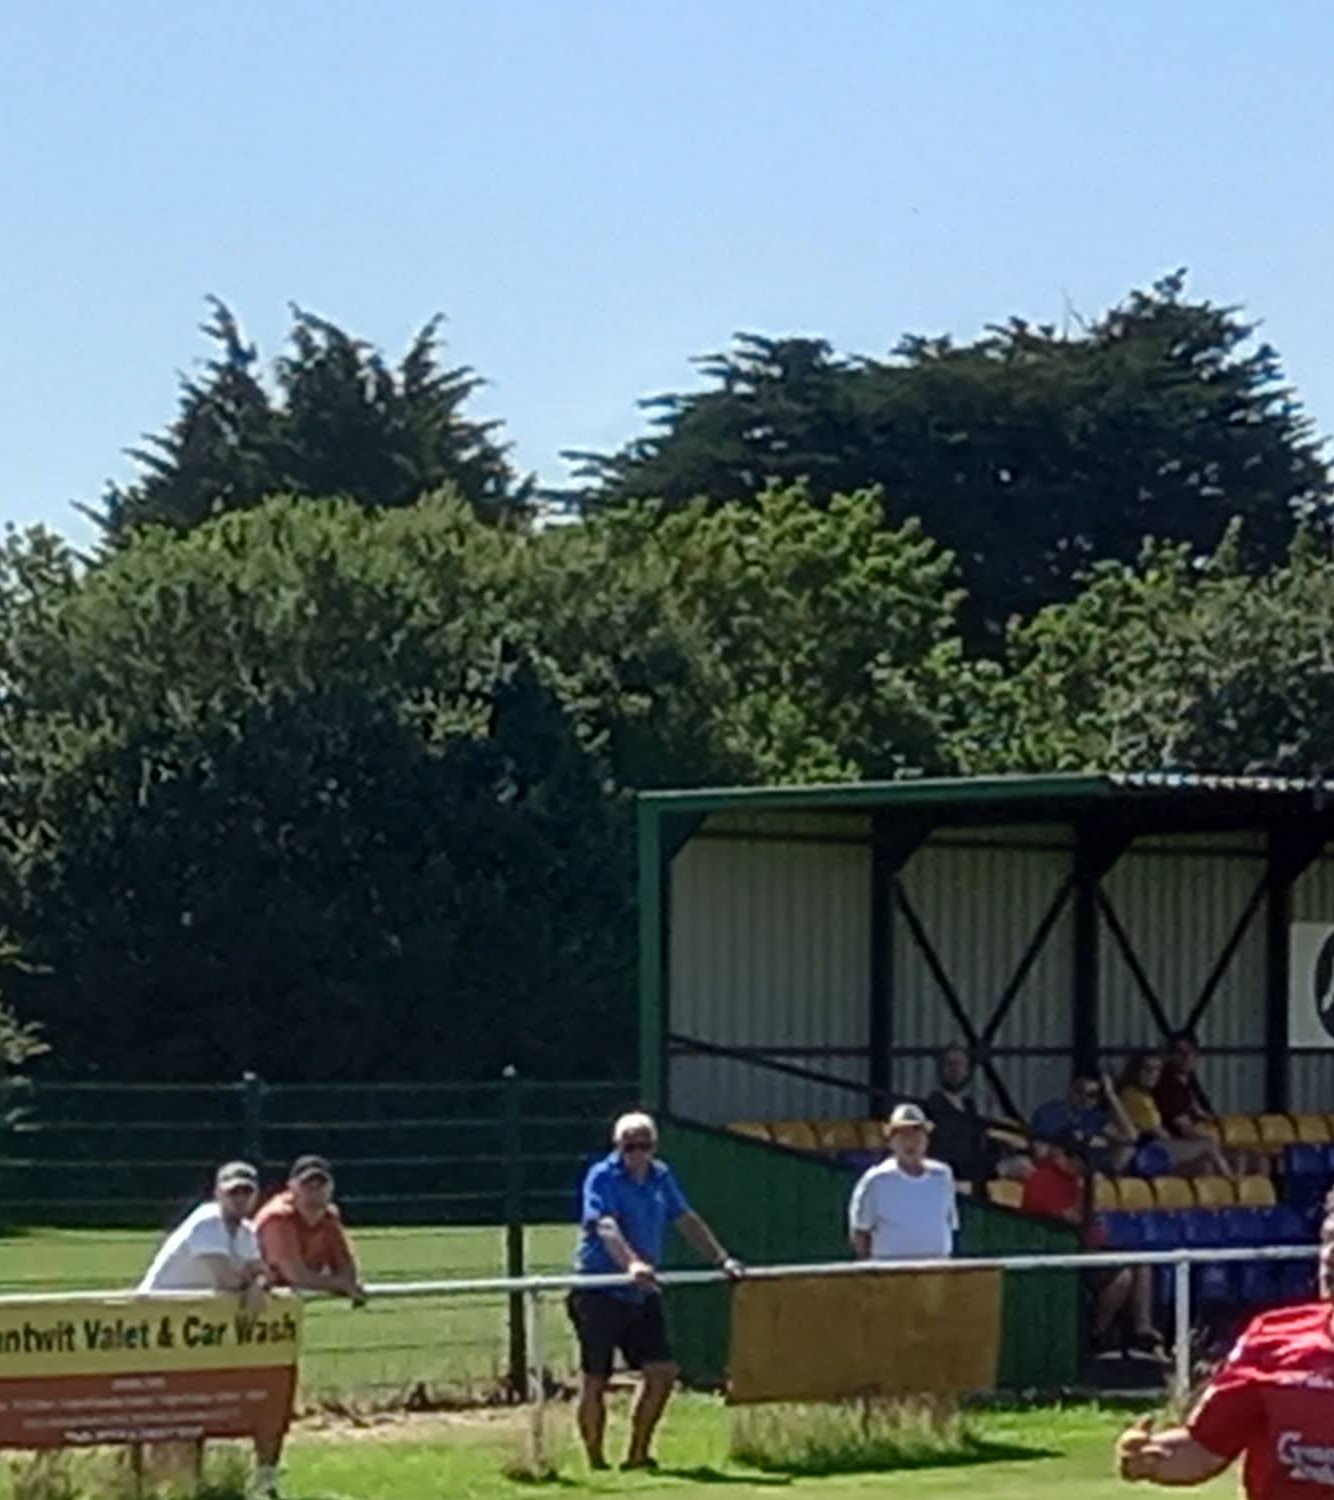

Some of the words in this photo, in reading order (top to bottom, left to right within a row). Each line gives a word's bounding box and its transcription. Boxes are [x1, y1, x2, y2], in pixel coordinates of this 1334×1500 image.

[84, 1319, 149, 1349] Valet
[157, 1316, 173, 1347] &
[183, 1315, 227, 1348] Car
[235, 1312, 297, 1346] Wash
